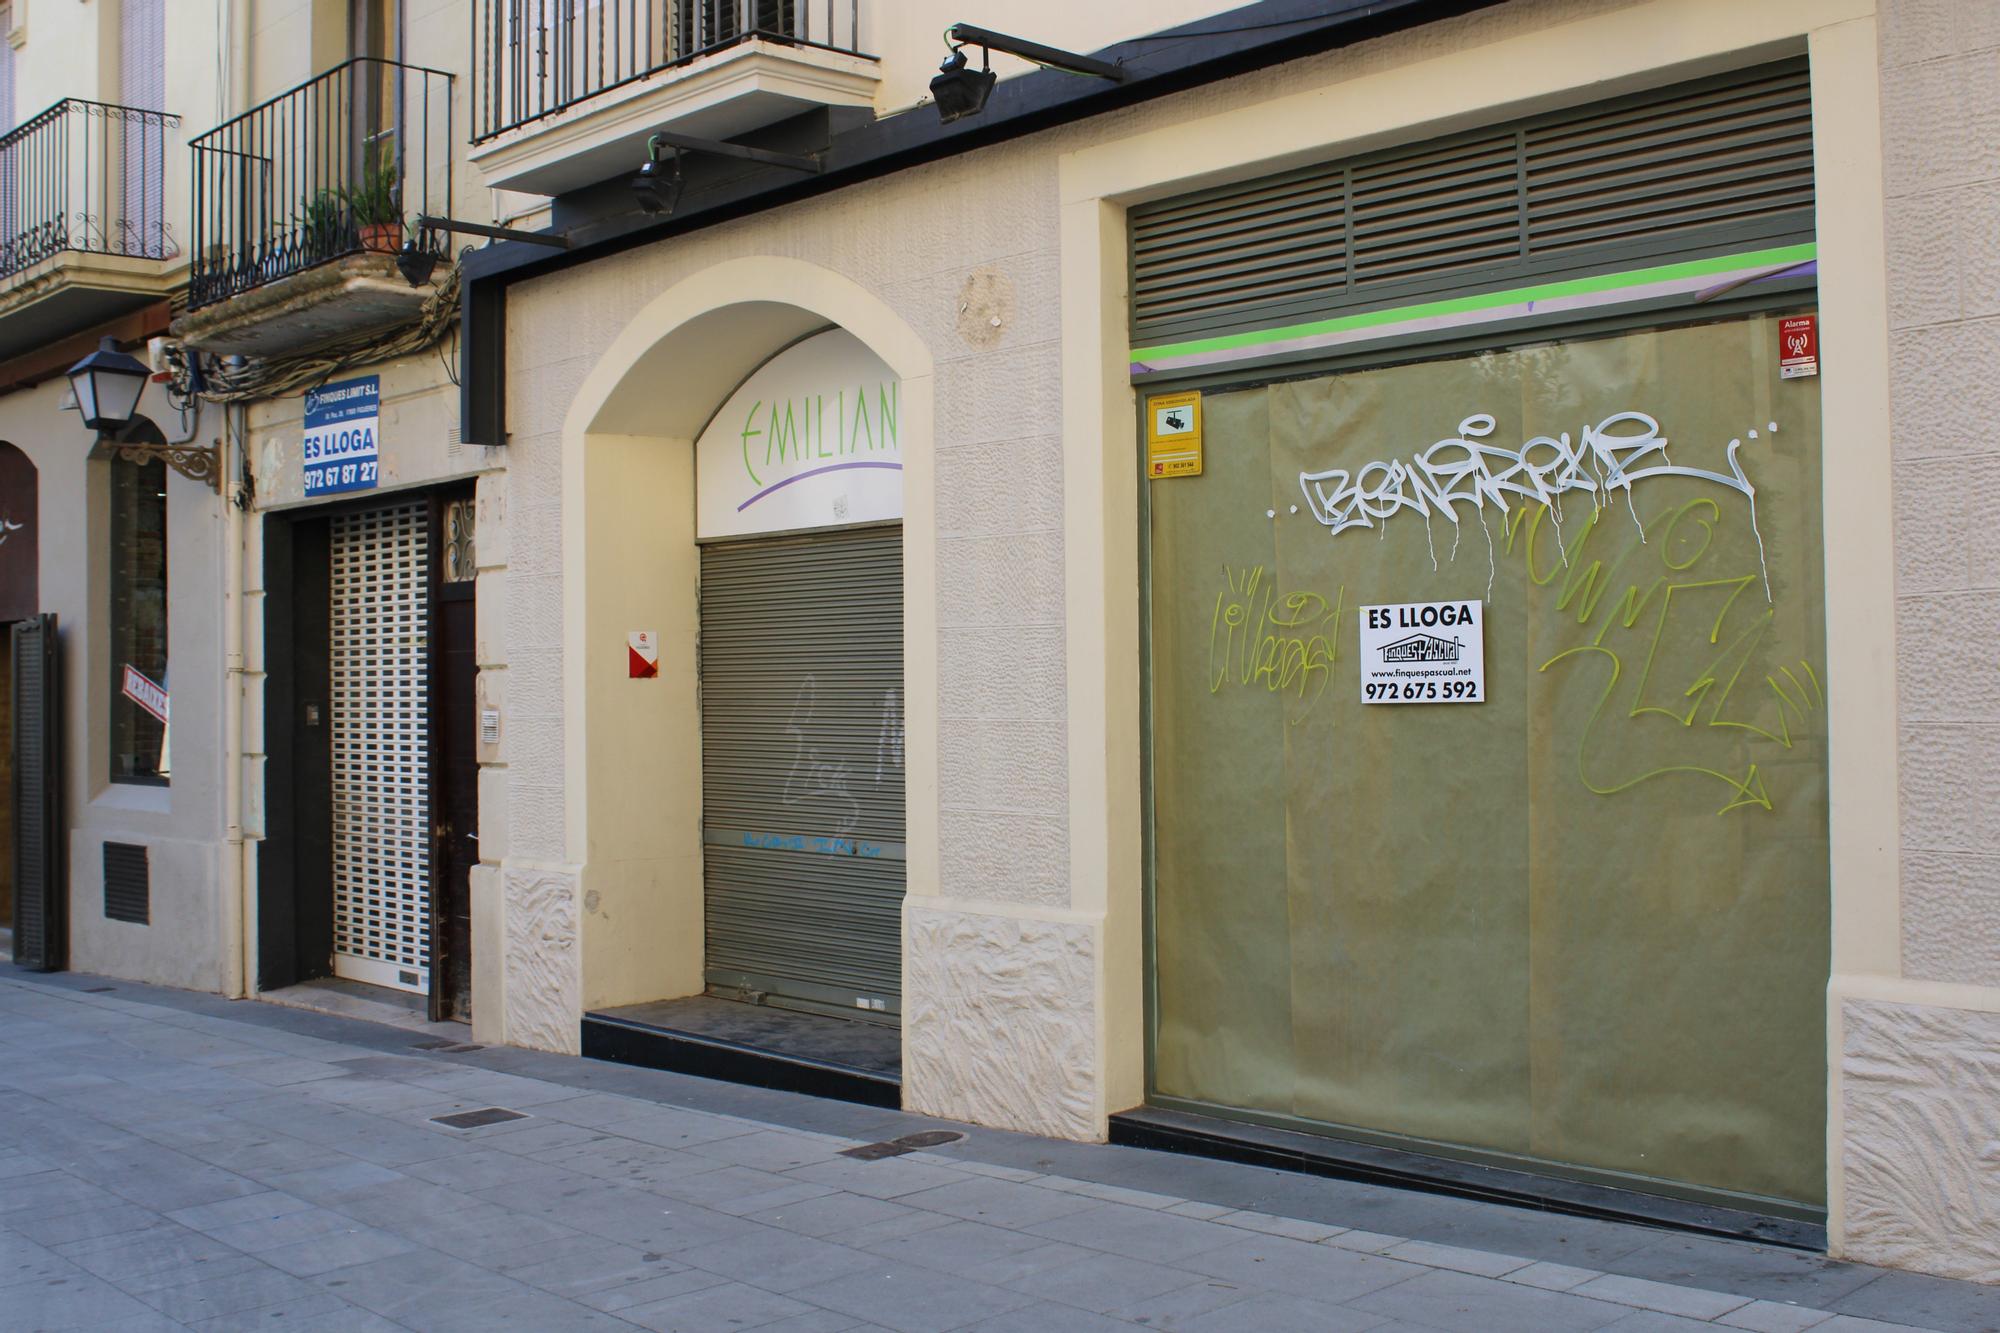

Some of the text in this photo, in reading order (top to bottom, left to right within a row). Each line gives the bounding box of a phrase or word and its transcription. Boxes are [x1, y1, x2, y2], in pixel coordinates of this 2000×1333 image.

[1784, 319, 1810, 328] Alarma
[305, 427, 375, 459] ES LLOGA
[741, 381, 897, 487] EMILIAN
[305, 461, 378, 490] 972 67 87 27
[1368, 604, 1474, 629] ES LLOGA
[1371, 667, 1471, 679] www.finquespascual.net
[1365, 681, 1477, 699] 972 675 592
